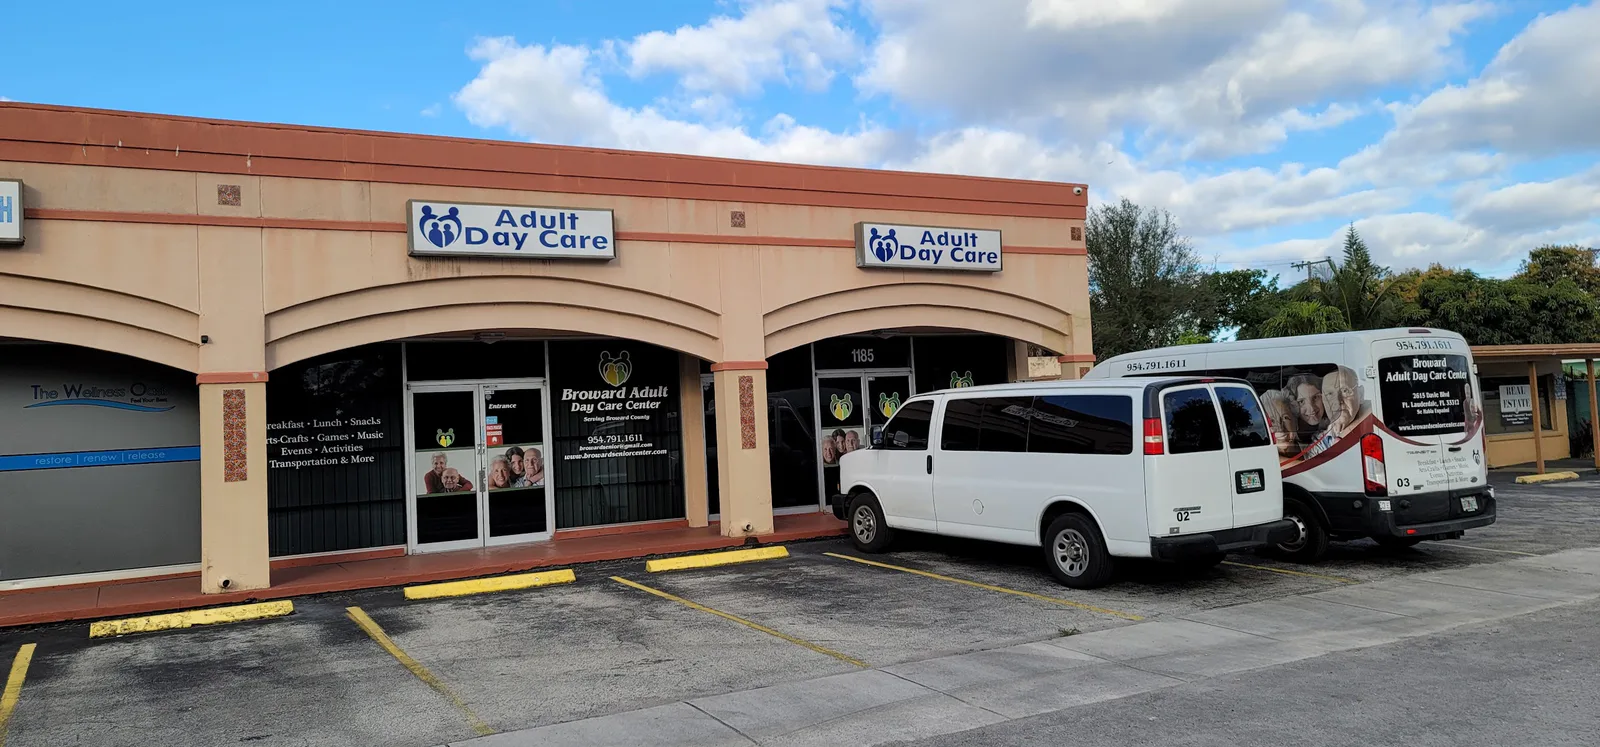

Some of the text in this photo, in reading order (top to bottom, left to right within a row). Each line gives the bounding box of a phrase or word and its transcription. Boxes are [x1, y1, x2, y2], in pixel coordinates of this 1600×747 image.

[495, 209, 578, 230] Adult
[465, 227, 608, 250] Day Care
[920, 231, 978, 247] Adult
[900, 245, 997, 264] Day Care
[1396, 341, 1452, 350] 954.791.1611
[852, 349, 874, 362] 1185
[1127, 360, 1186, 371] 954.791.1611
[1413, 358, 1447, 368] Broward
[1386, 370, 1467, 382] Adult Day Care Center
[31, 385, 58, 399] The
[63, 384, 125, 398] Wellness
[562, 386, 668, 400] Broward Adult
[1506, 386, 1525, 395] REAL
[571, 400, 661, 413] Day Care Center
[1503, 400, 1530, 408] ESTATE
[266, 417, 380, 430] reakfast Lunch Snacks
[266, 435, 308, 444] rts-Crafts
[357, 431, 383, 439] Music
[588, 434, 643, 444] 954.791.1611
[281, 444, 363, 455] Events Activities
[36, 451, 165, 464] restore renew release
[269, 457, 338, 469] Transportation
[351, 455, 374, 463] More
[1397, 478, 1410, 487] 03
[1177, 512, 1189, 521] 02
